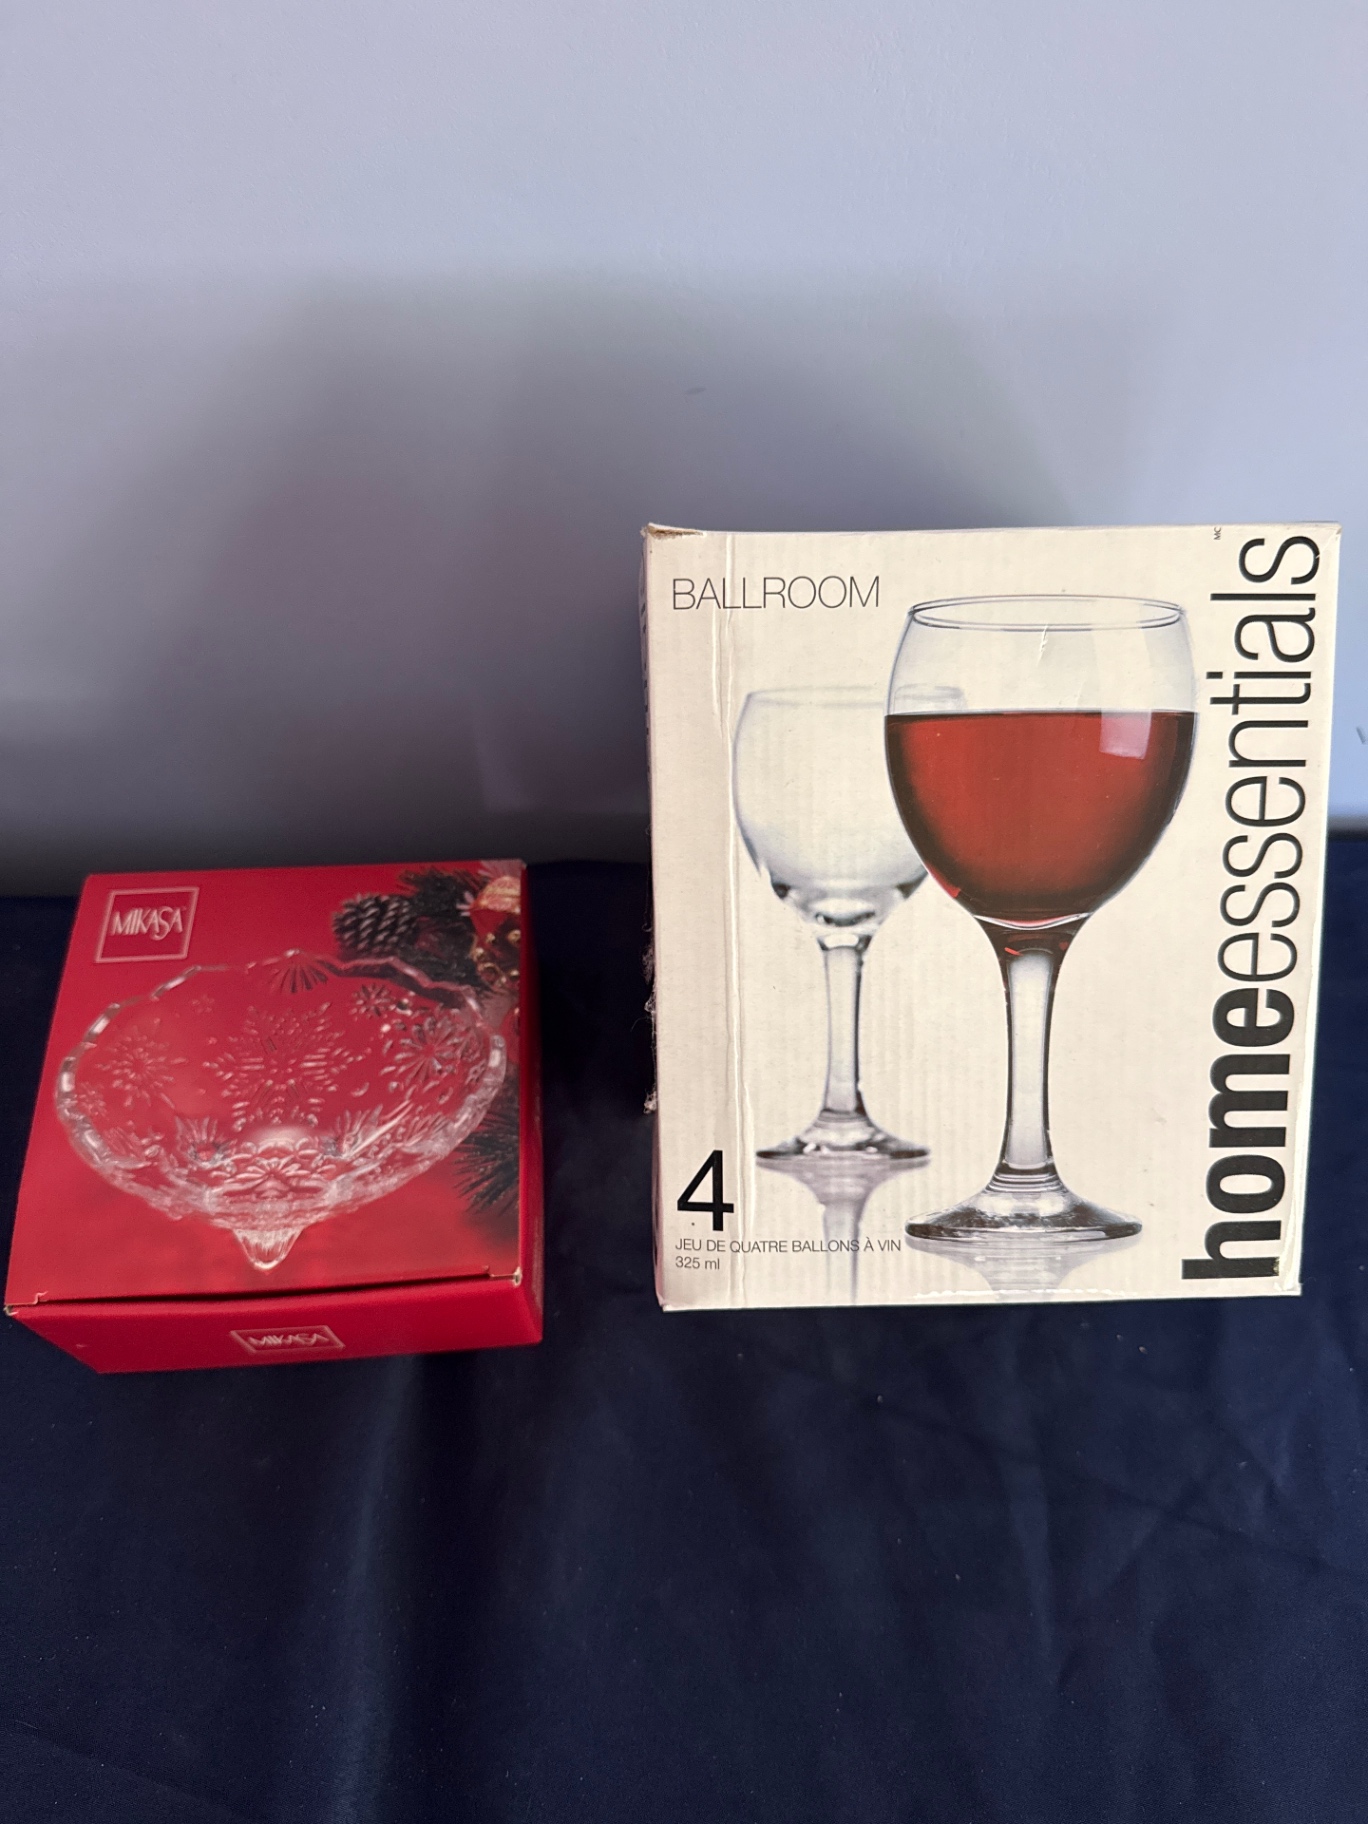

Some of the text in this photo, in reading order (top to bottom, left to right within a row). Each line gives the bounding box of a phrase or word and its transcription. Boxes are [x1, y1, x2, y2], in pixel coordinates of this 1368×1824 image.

[672, 575, 880, 610] BALLROOM
[110, 906, 184, 941] MIKASA
[677, 1149, 735, 1232] 4
[675, 1236, 902, 1253] JEU DE QUATRE BALLONS À VIN
[675, 1256, 721, 1270] 325 ml
